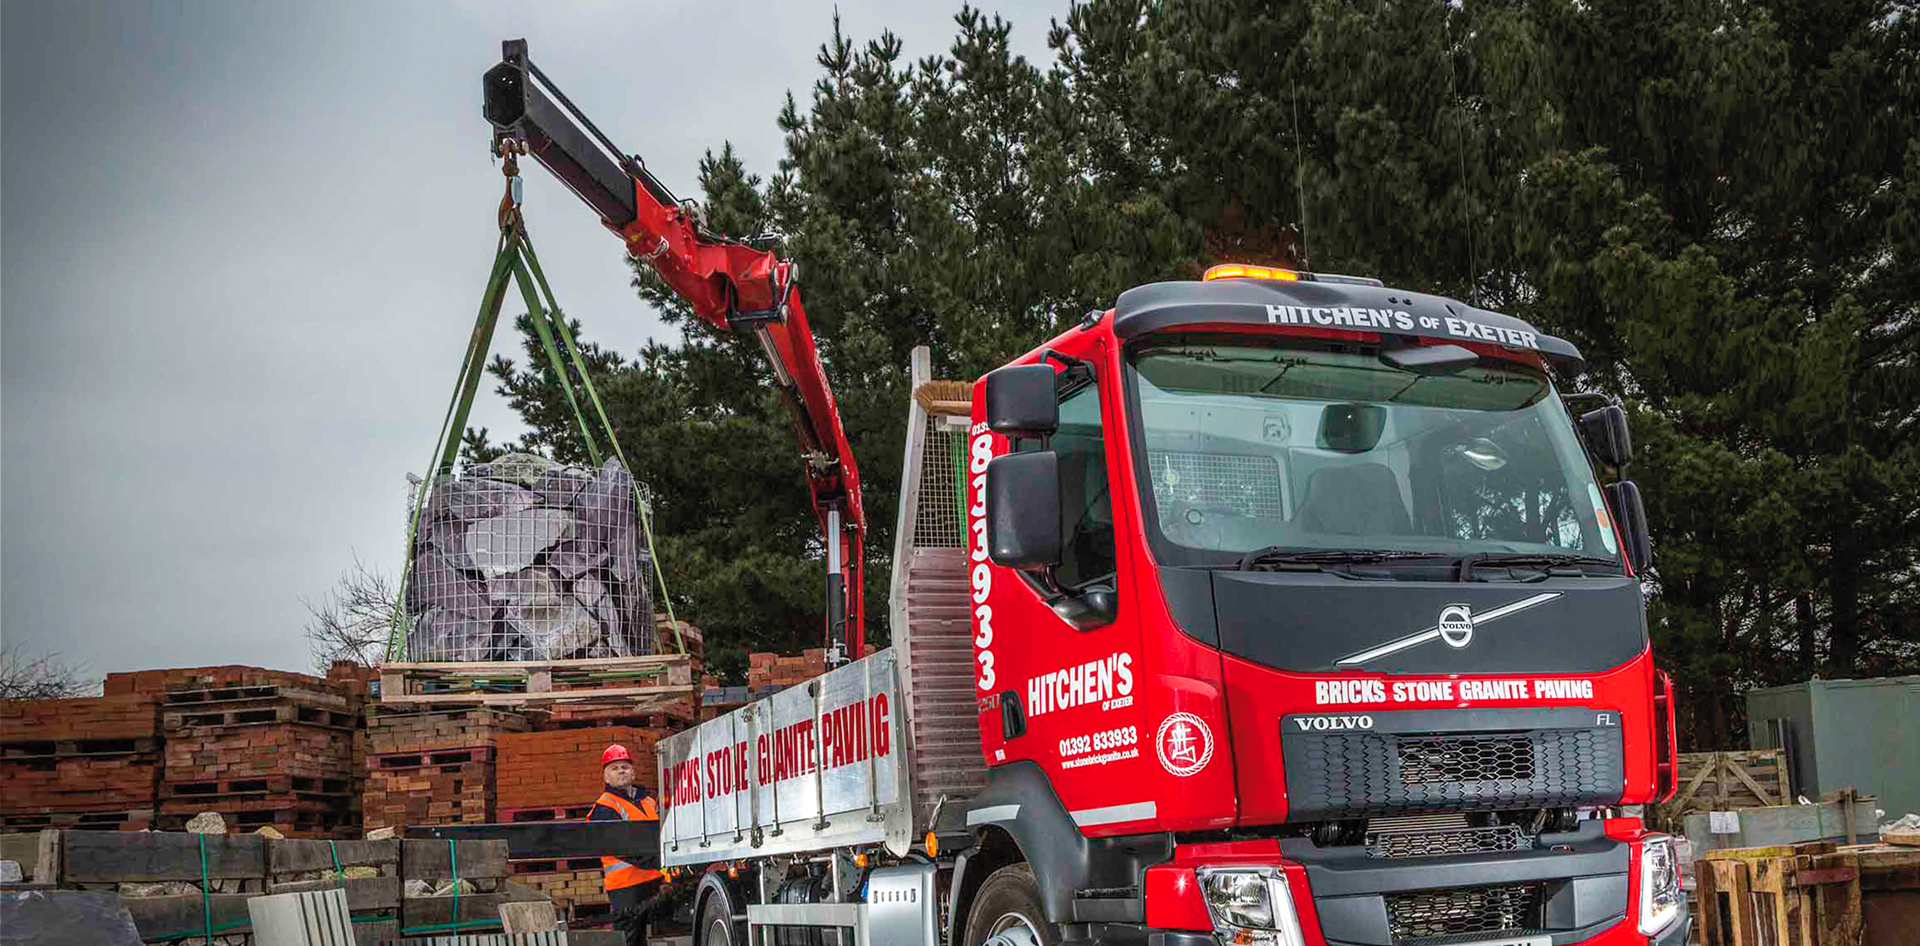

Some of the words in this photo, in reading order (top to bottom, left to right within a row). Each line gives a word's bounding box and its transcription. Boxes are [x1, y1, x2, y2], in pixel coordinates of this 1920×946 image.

[1265, 304, 1414, 330] HITCHEN'S
[1419, 317, 1440, 330] OF
[1444, 317, 1539, 350] EXETER
[1028, 652, 1133, 717] HITCHEN'S
[1315, 679, 1386, 705] BRICKS
[1393, 681, 1454, 702] STONE
[1459, 681, 1529, 701] GRANITE
[1535, 680, 1593, 700] PAVING
[1294, 715, 1374, 731] VOLVO
[1596, 713, 1615, 726] FL
[1059, 734, 1092, 758] 01392
[1093, 725, 1137, 751] 833933
